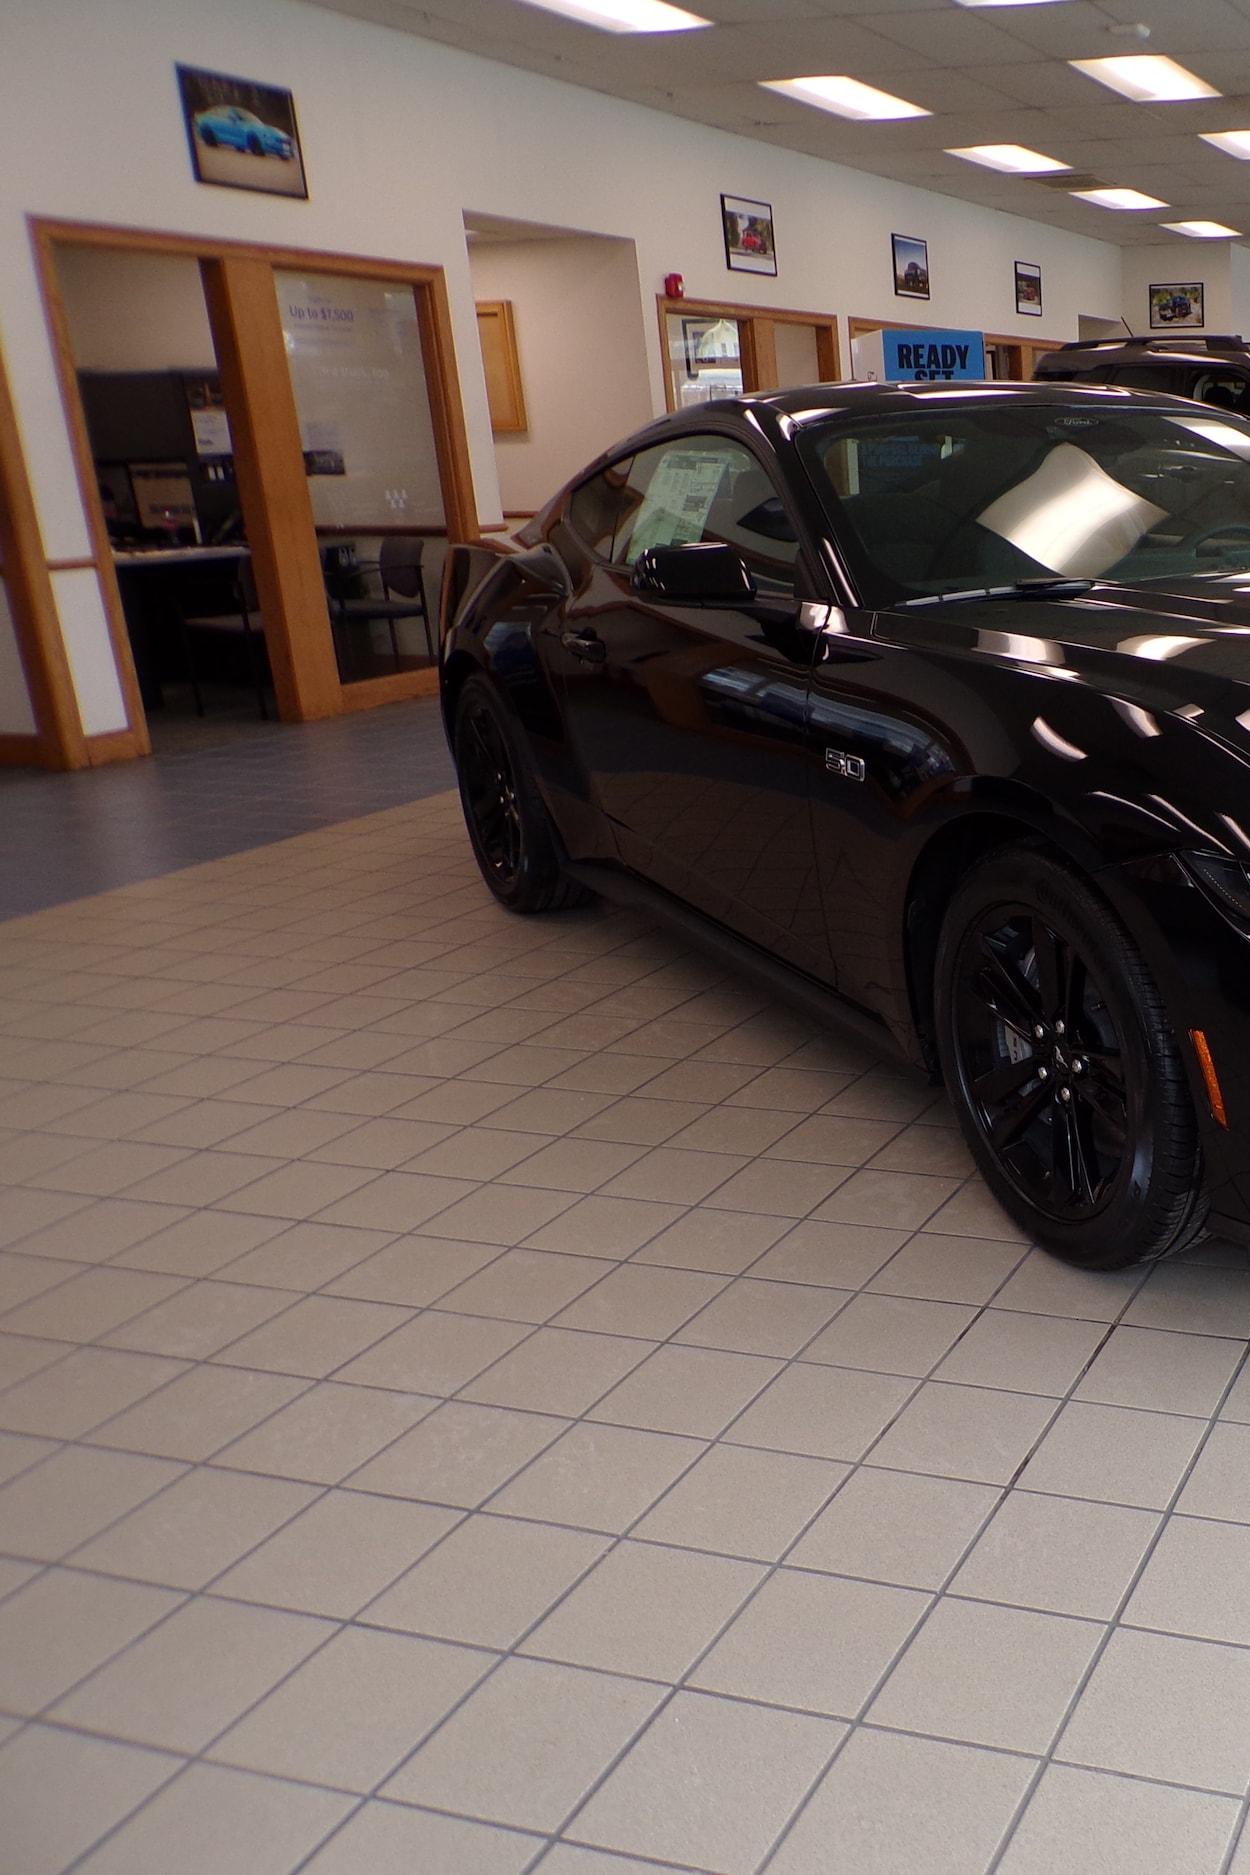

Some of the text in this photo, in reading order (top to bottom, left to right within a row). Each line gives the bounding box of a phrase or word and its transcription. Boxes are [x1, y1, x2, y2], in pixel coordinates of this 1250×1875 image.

[289, 304, 305, 320] Up
[307, 306, 319, 320] to
[897, 344, 969, 370] READY
